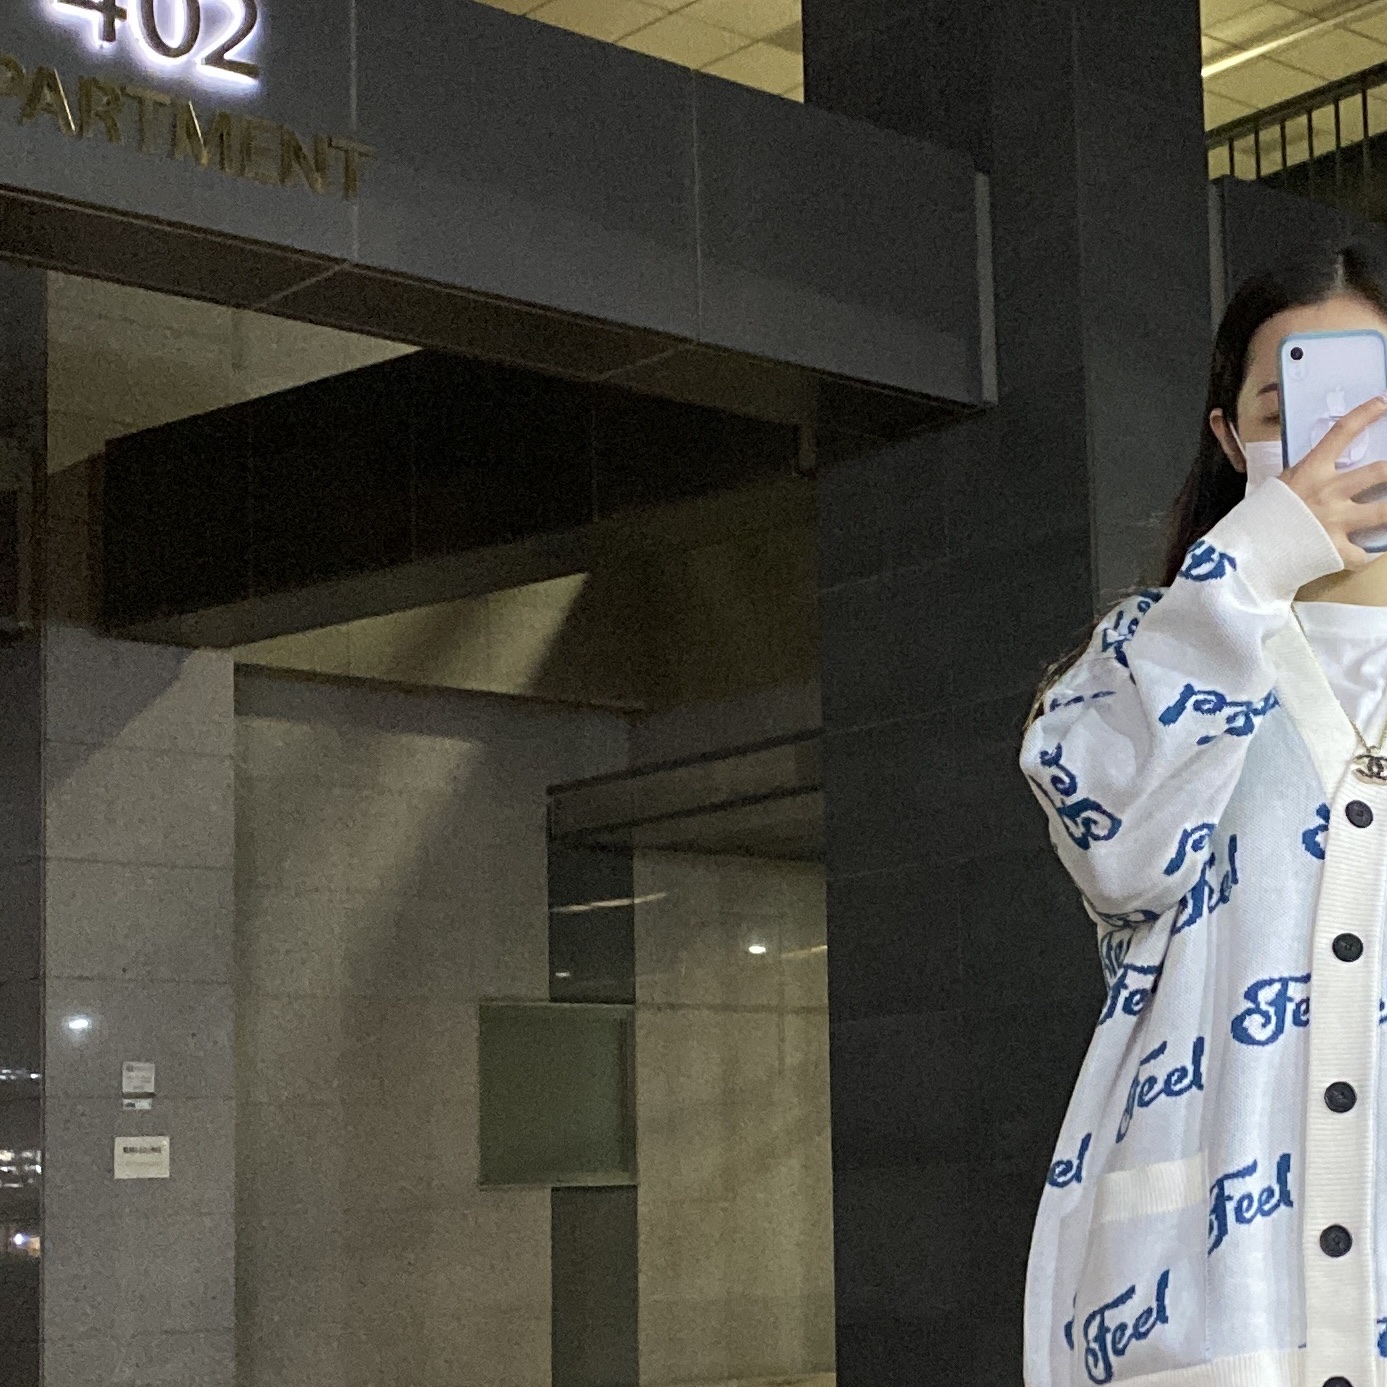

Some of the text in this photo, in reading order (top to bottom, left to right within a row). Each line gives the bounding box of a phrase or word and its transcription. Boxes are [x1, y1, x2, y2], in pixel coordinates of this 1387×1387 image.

[1116, 1036, 1205, 1144] Feel
[1048, 1132, 1092, 1188] el
[1208, 1153, 1294, 1258] Feel
[1083, 1269, 1170, 1385] Feel
